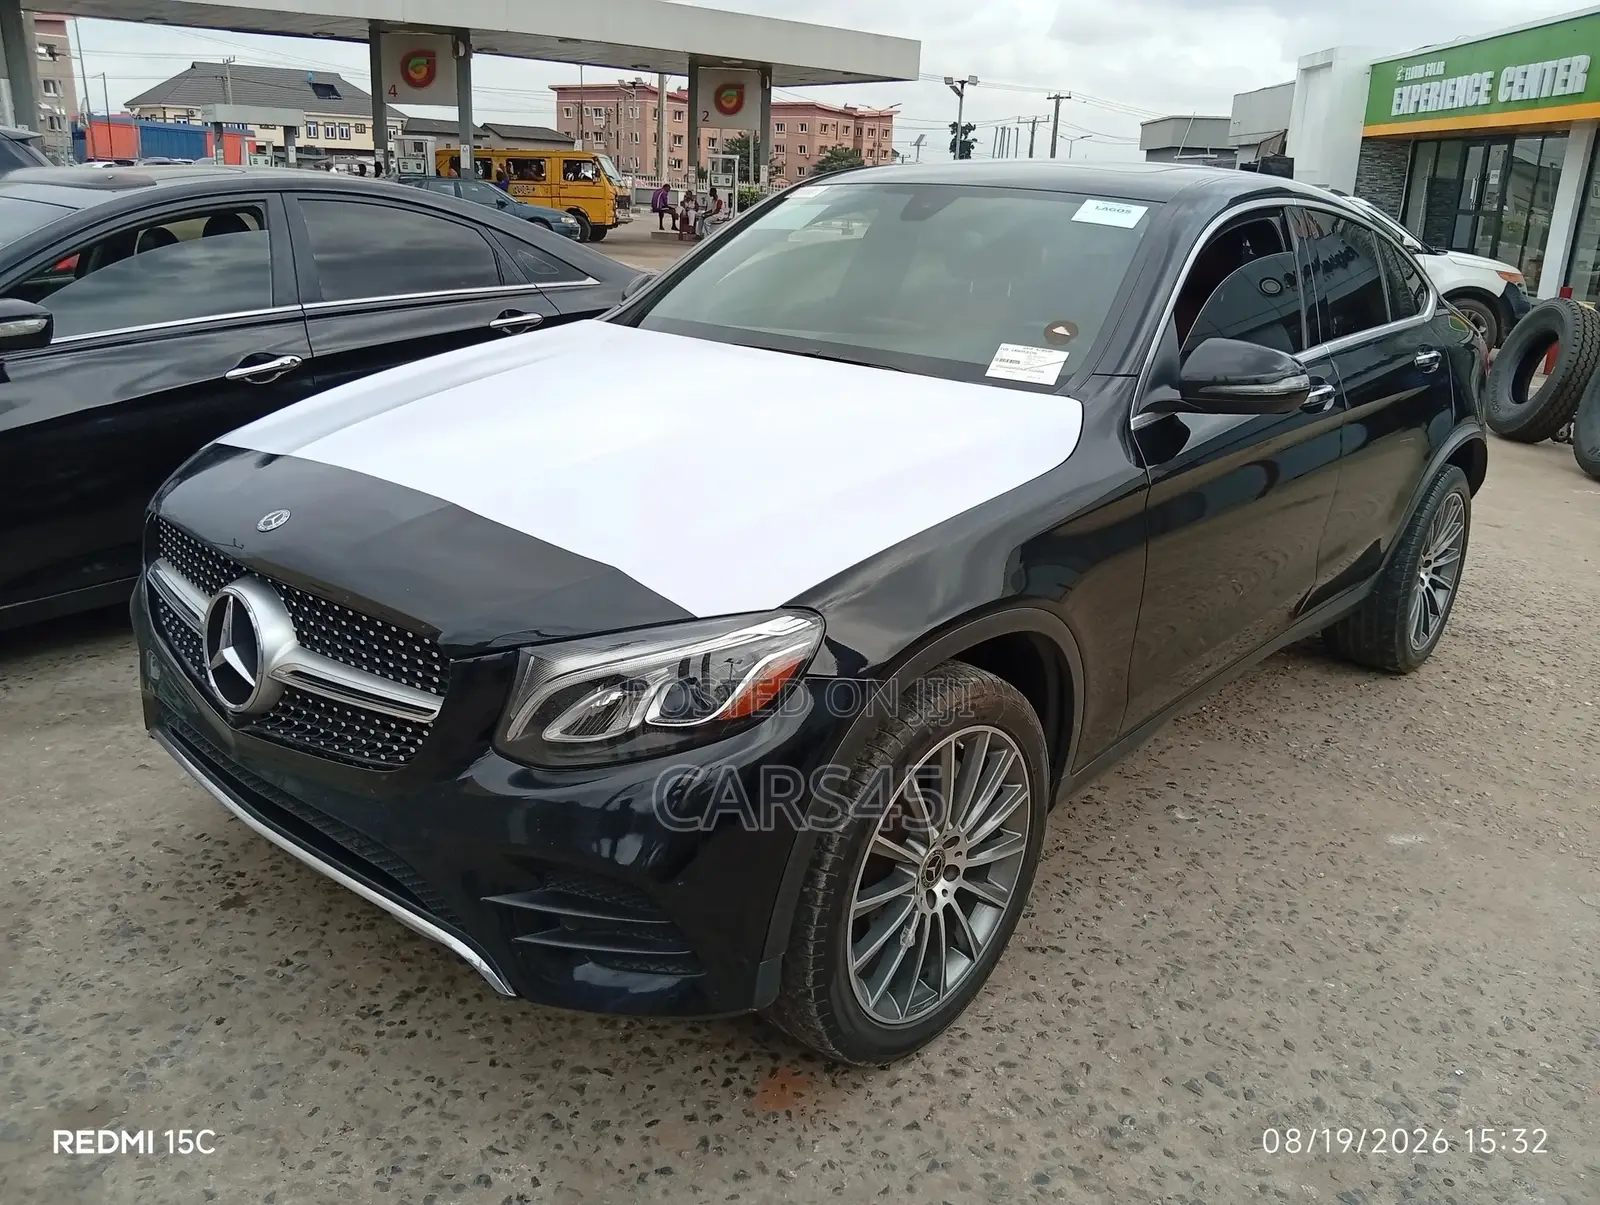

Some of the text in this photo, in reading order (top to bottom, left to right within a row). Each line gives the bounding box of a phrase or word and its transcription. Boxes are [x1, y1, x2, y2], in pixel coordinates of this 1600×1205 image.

[388, 84, 398, 97] 4
[1391, 54, 1591, 116] EXPERIENCE CENTER
[702, 111, 709, 122] 2
[1095, 205, 1132, 214] LAGOS
